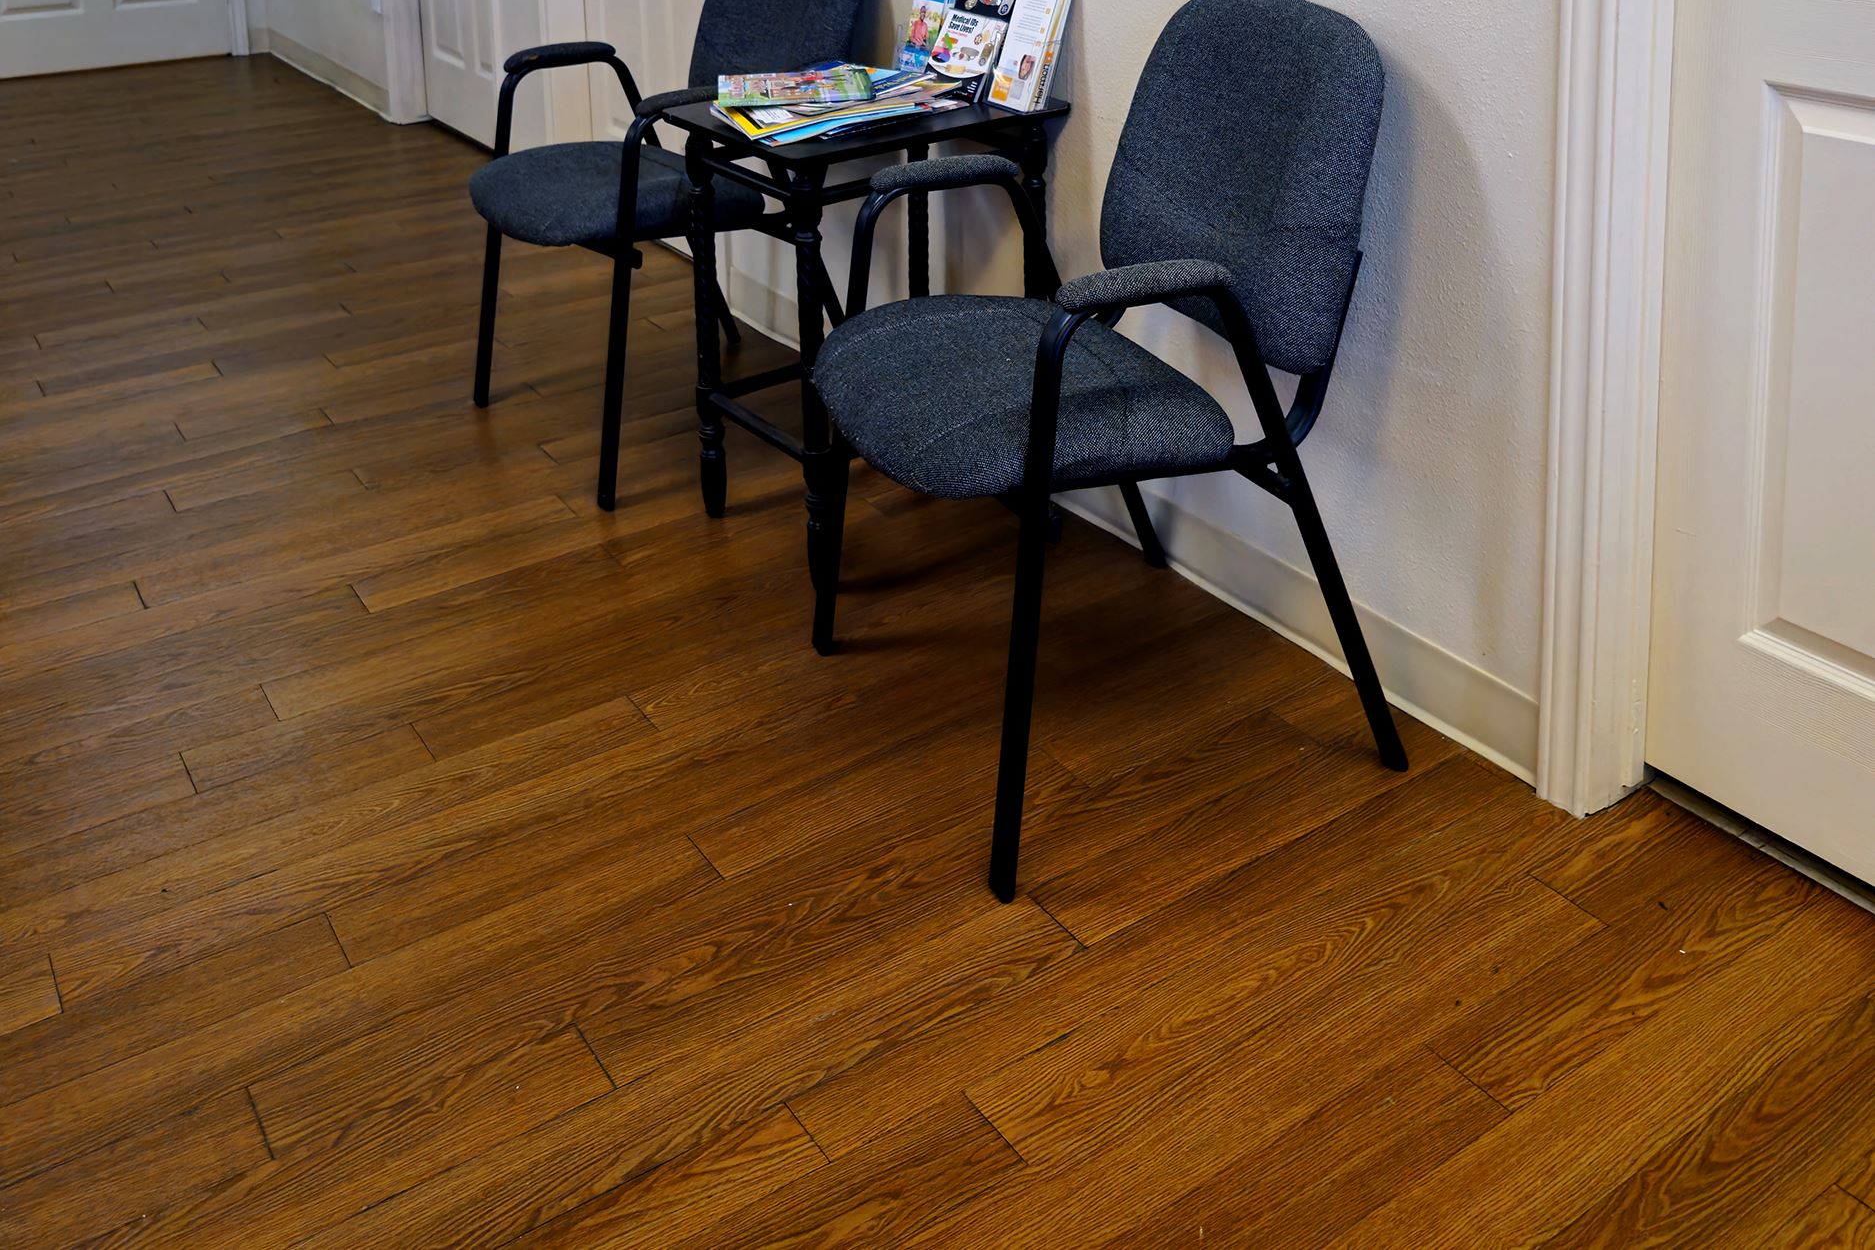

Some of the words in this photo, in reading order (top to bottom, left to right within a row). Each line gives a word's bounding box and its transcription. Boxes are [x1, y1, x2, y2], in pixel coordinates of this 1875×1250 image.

[951, 14, 971, 25] Medical
[948, 21, 960, 30] Save
[960, 24, 974, 34] Lives!
